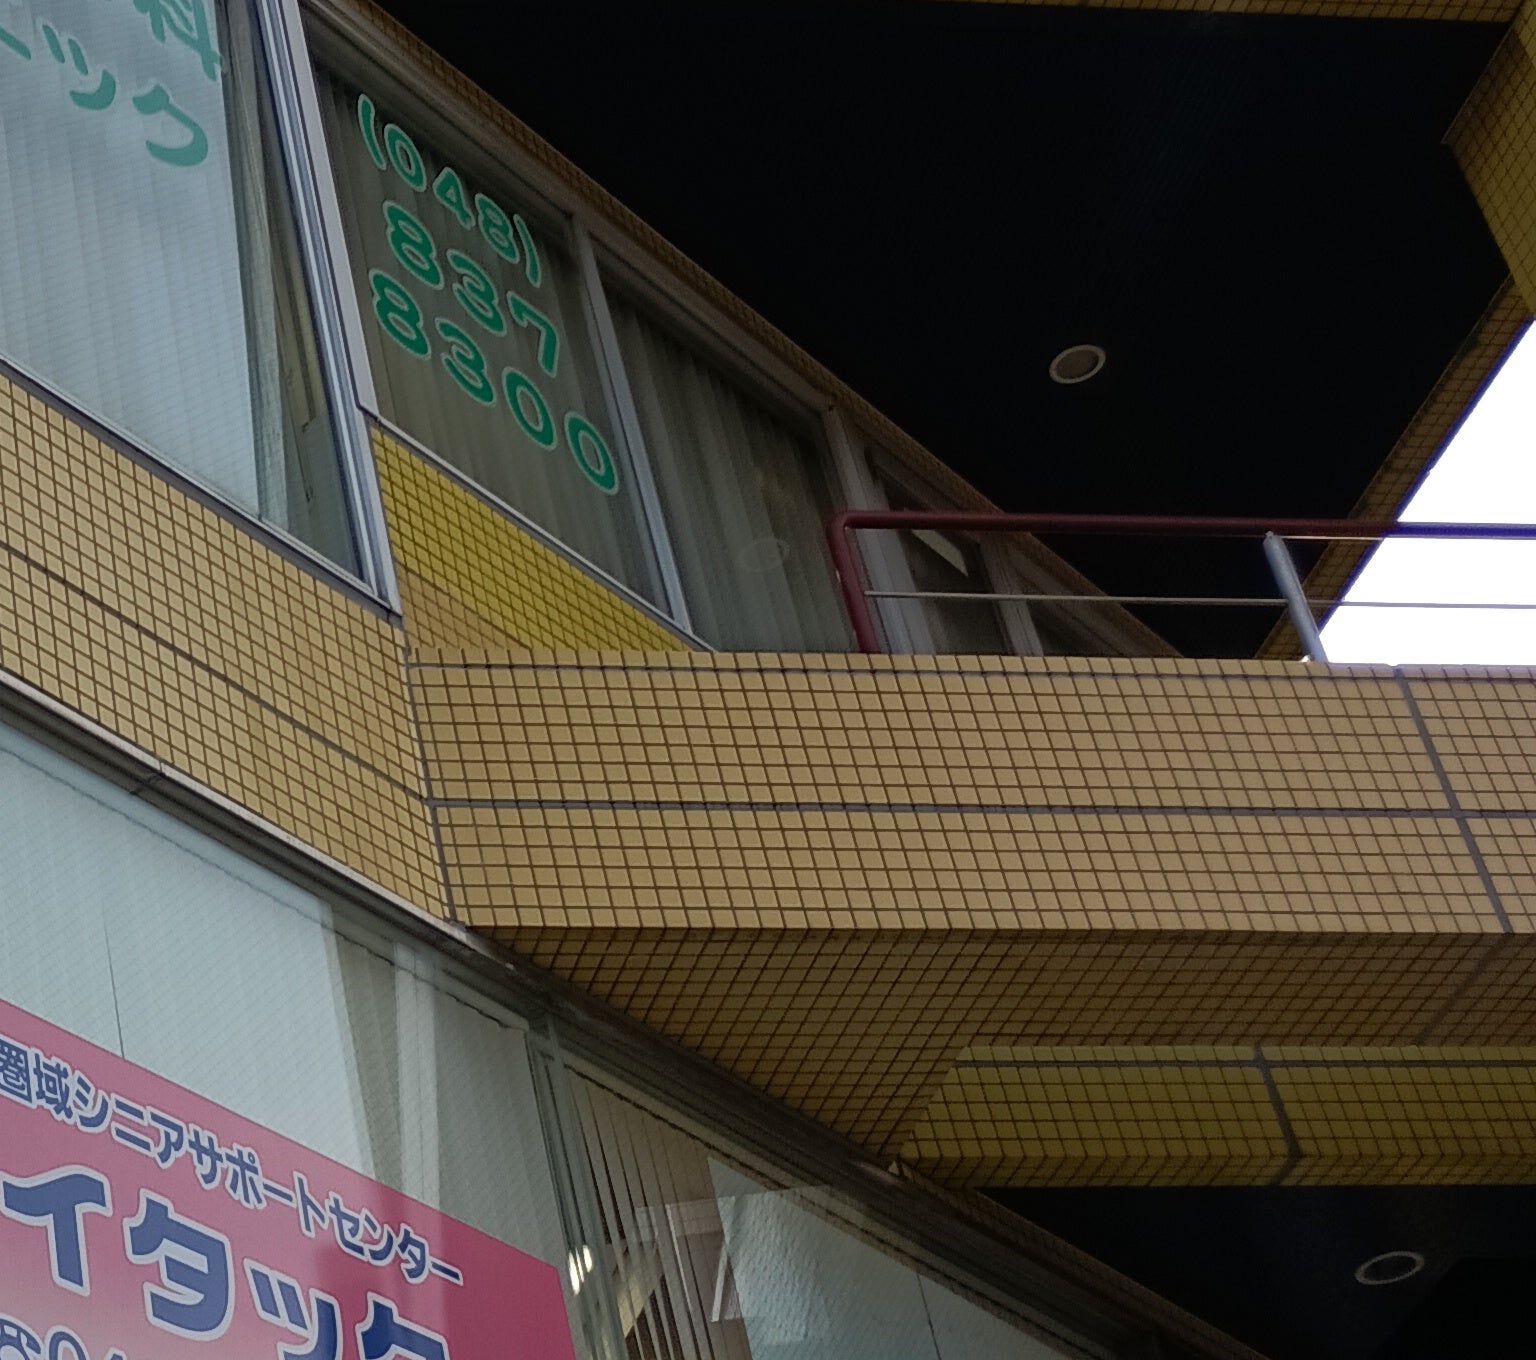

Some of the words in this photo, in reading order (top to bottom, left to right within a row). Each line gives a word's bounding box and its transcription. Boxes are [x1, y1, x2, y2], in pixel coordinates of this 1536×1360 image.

[358, 95, 541, 288] (048)
[369, 269, 618, 495] 8300
[383, 200, 559, 377] 837
